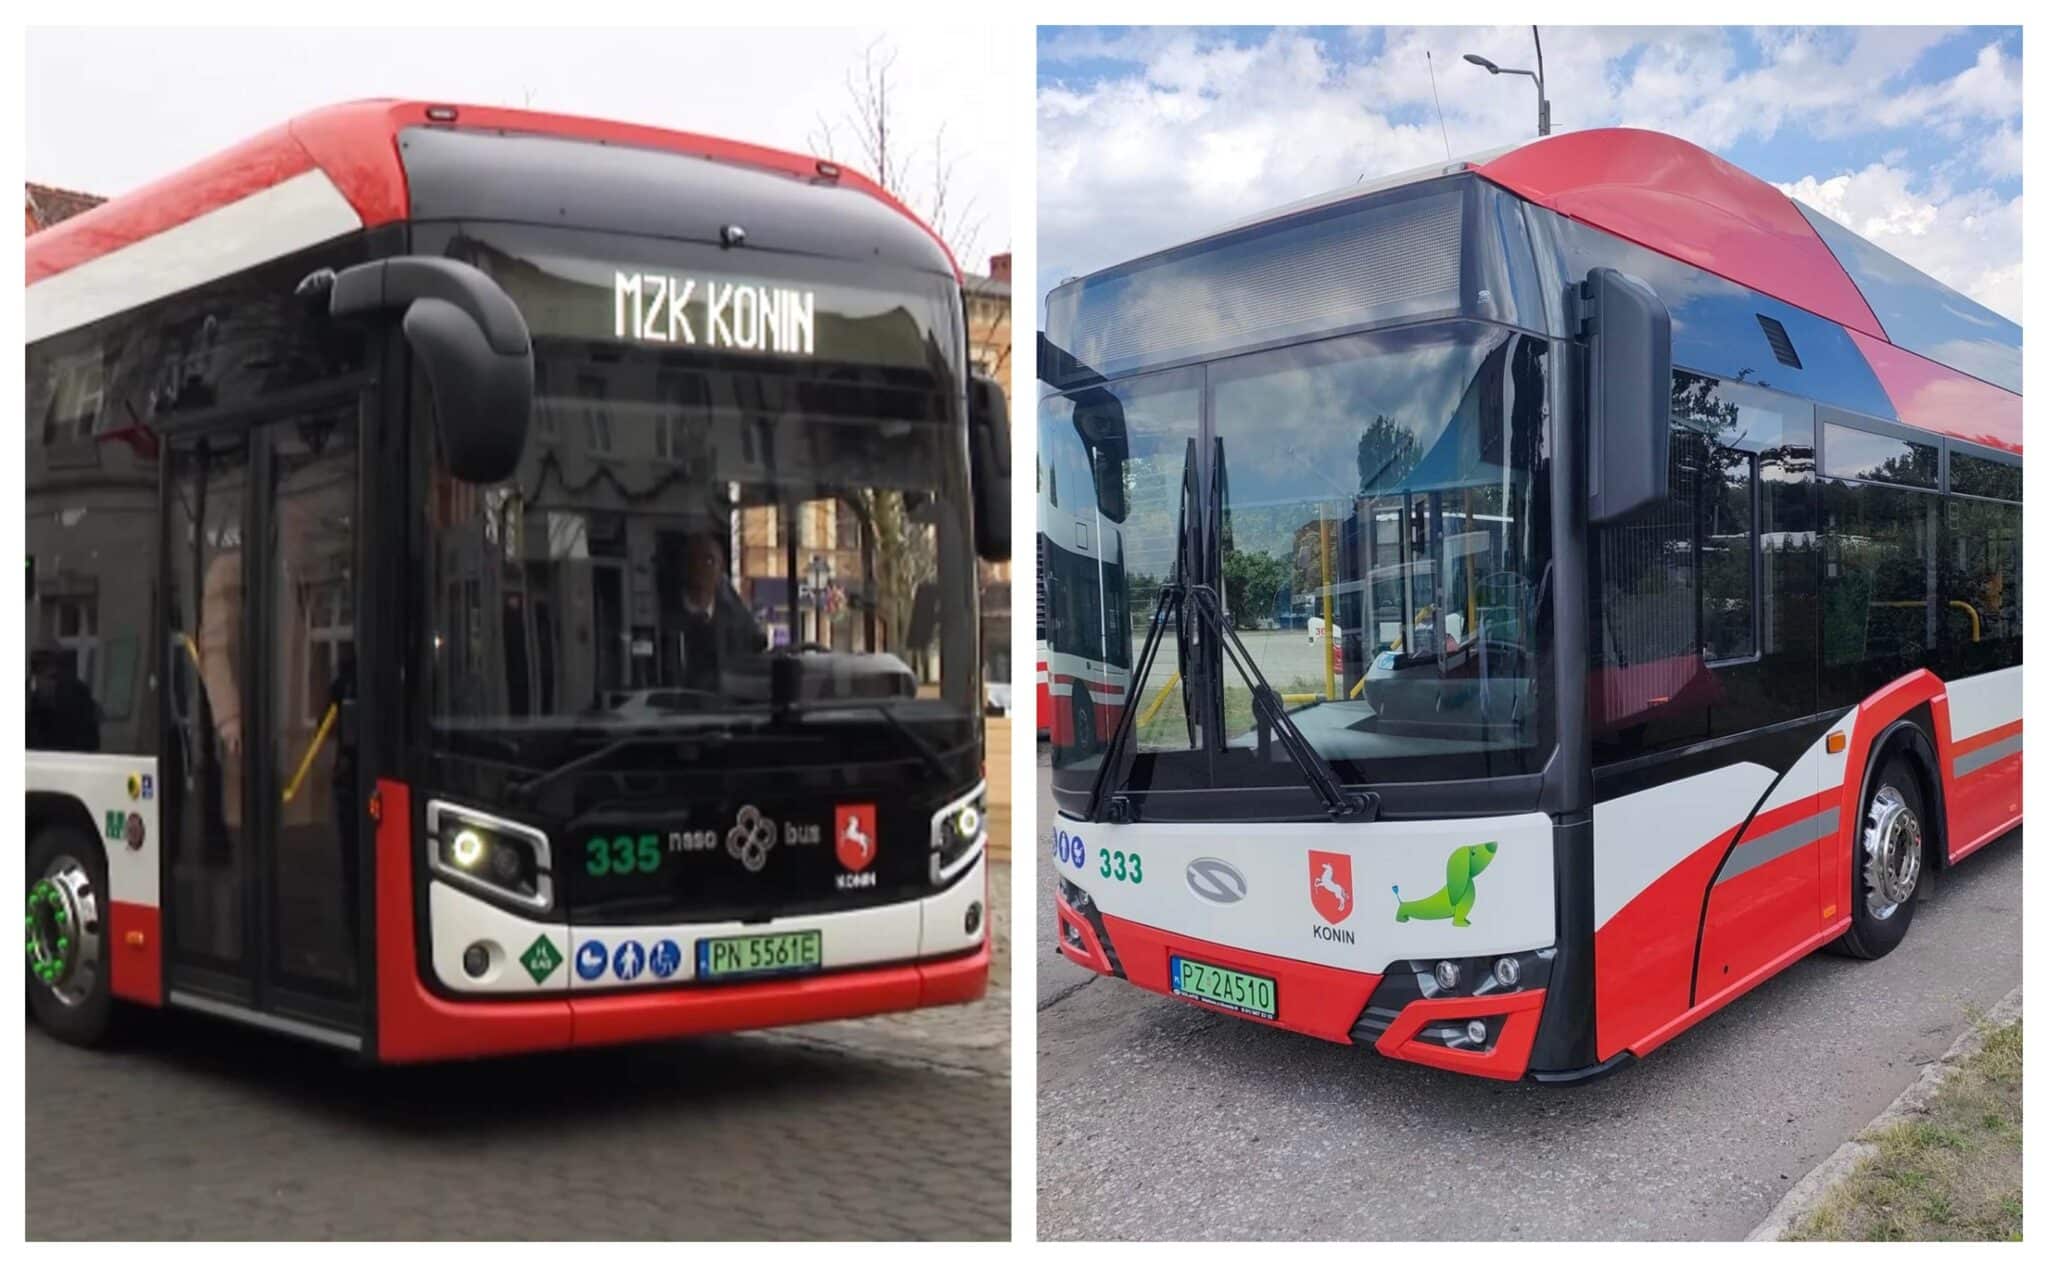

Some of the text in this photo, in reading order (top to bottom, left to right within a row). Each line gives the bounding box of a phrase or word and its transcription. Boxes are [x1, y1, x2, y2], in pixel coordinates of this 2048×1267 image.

[615, 271, 814, 354] MZK KONIN
[784, 821, 821, 845] bus
[586, 834, 662, 876] 335
[1100, 848, 1143, 884] 333
[713, 935, 815, 970] PN 5561E
[1313, 924, 1355, 945] KONIN
[1183, 963, 1206, 993] PZ
[1212, 970, 1269, 1009] 2A510
